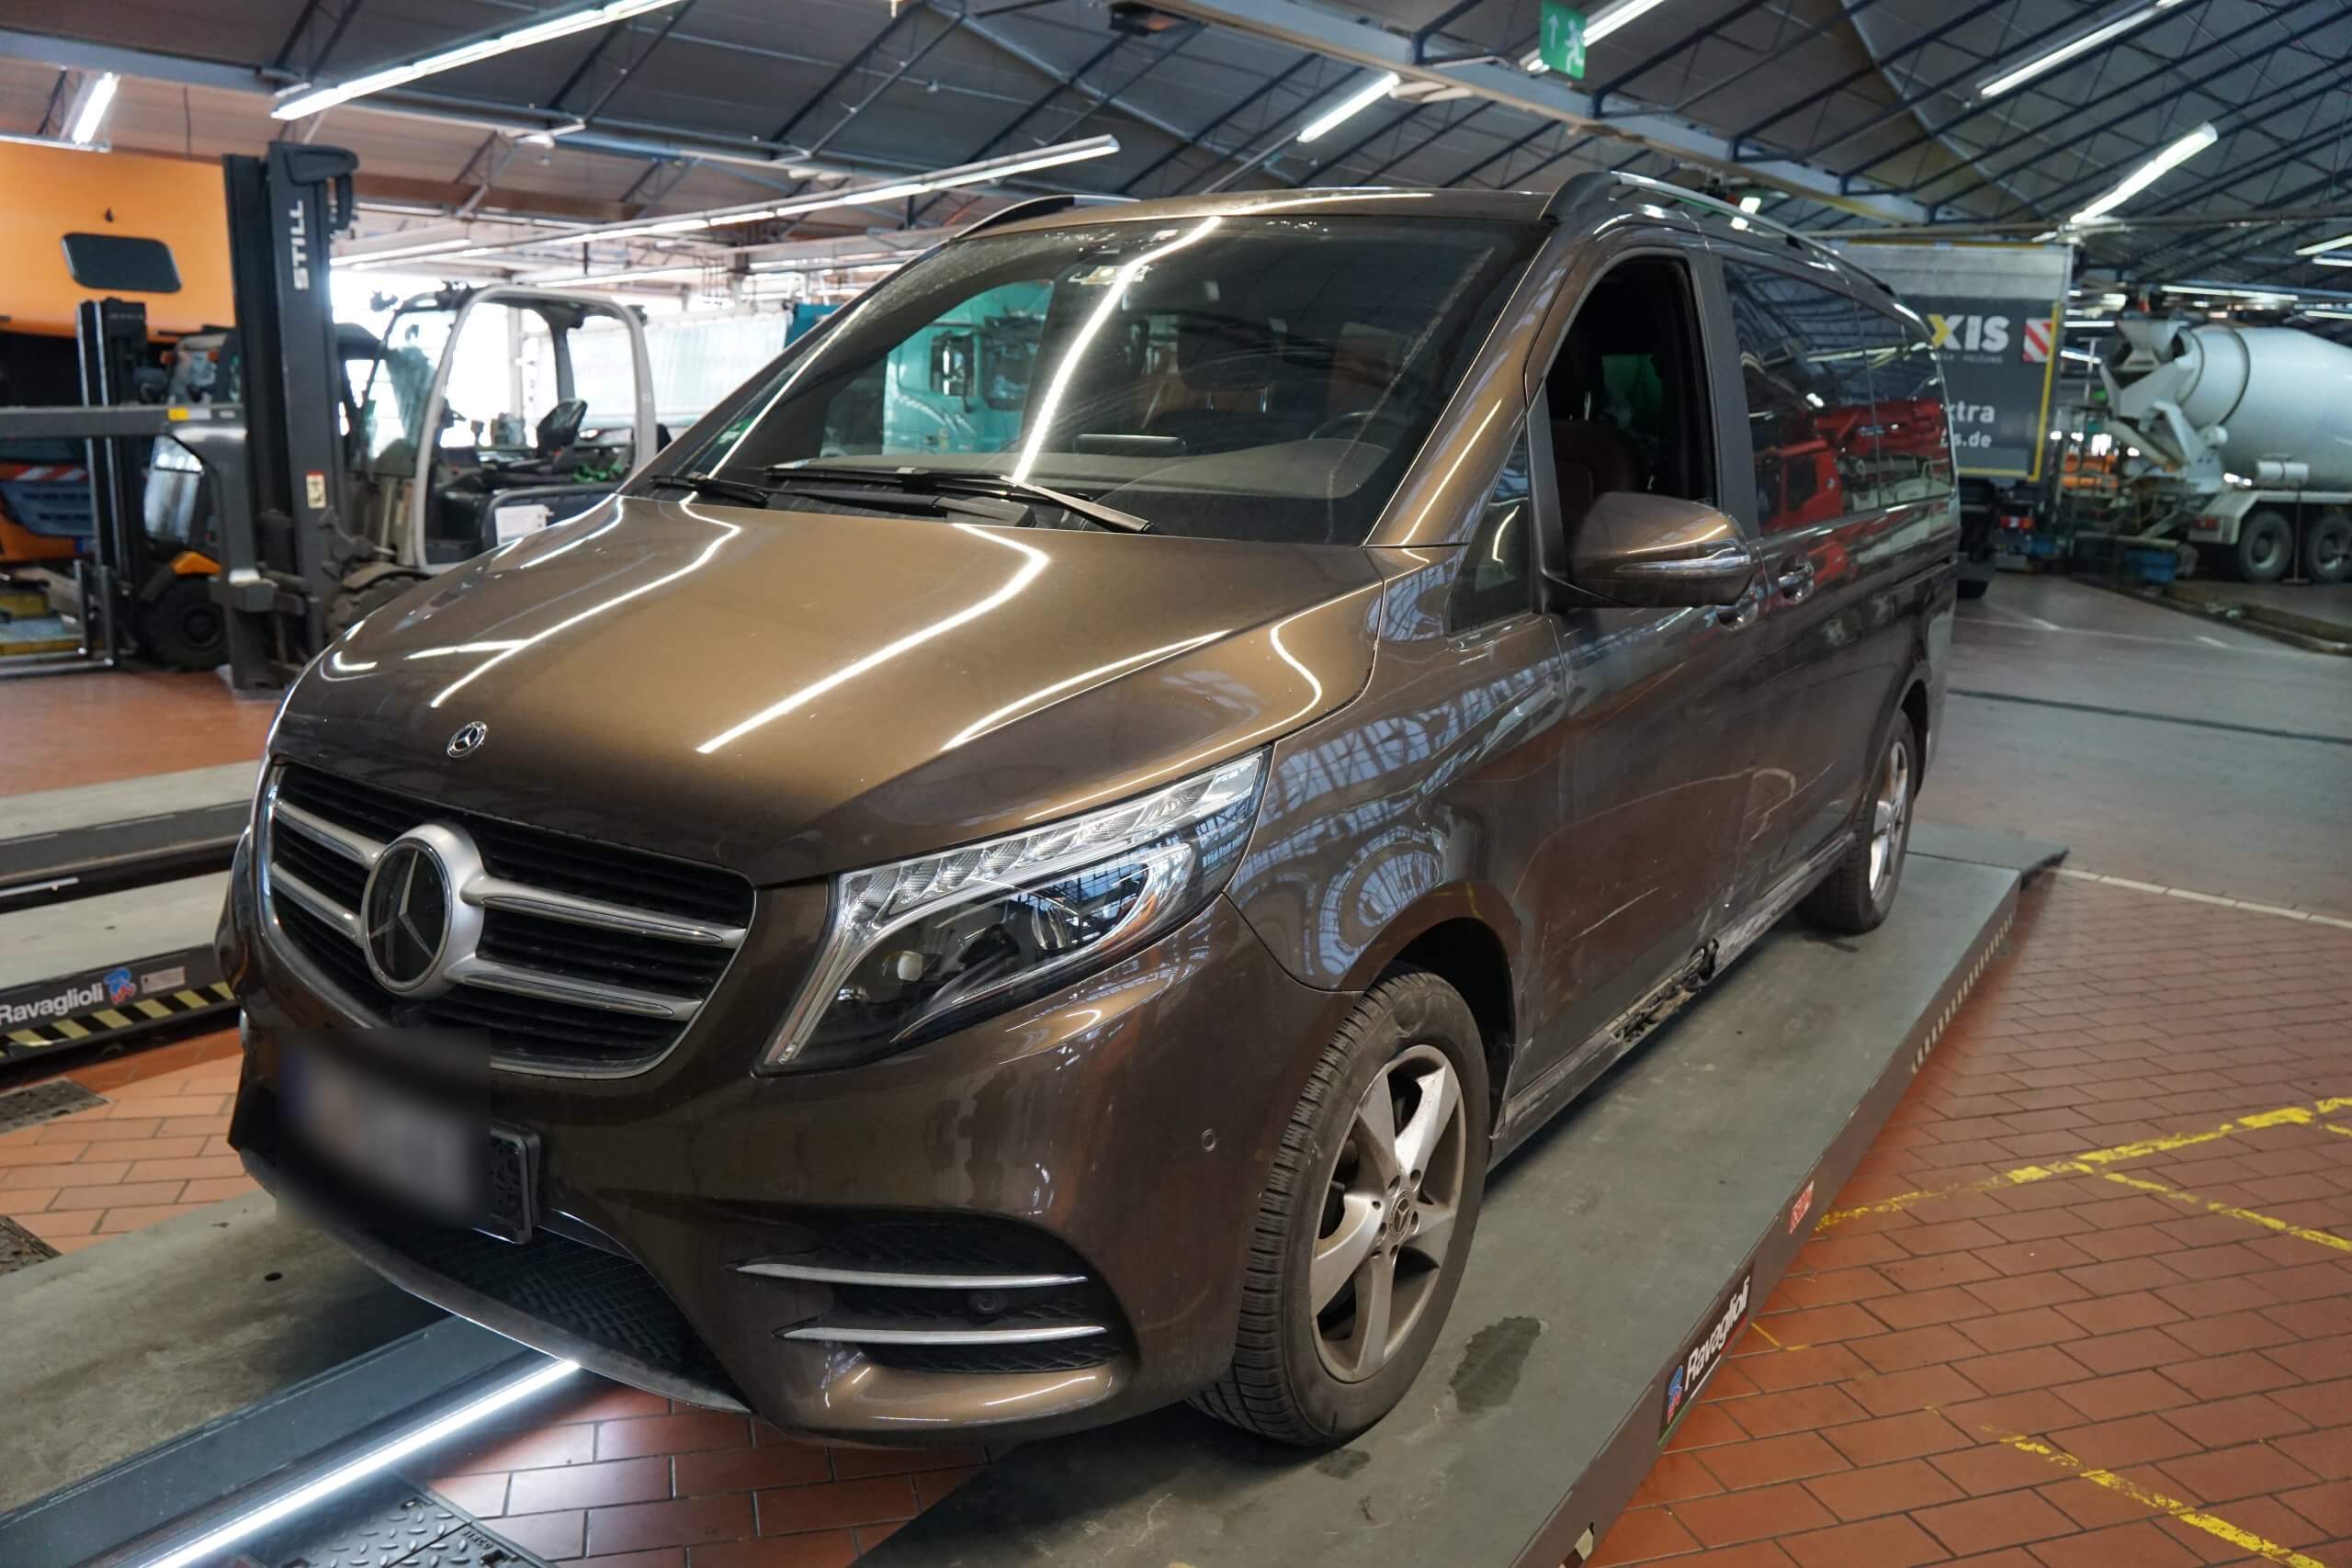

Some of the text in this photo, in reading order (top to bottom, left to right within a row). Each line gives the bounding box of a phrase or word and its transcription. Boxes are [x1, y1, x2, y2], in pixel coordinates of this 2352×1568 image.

[289, 199, 310, 289] STILL
[0, 982, 104, 1026] Ravaglioli
[1685, 1275, 1750, 1393] Ravaglioli
